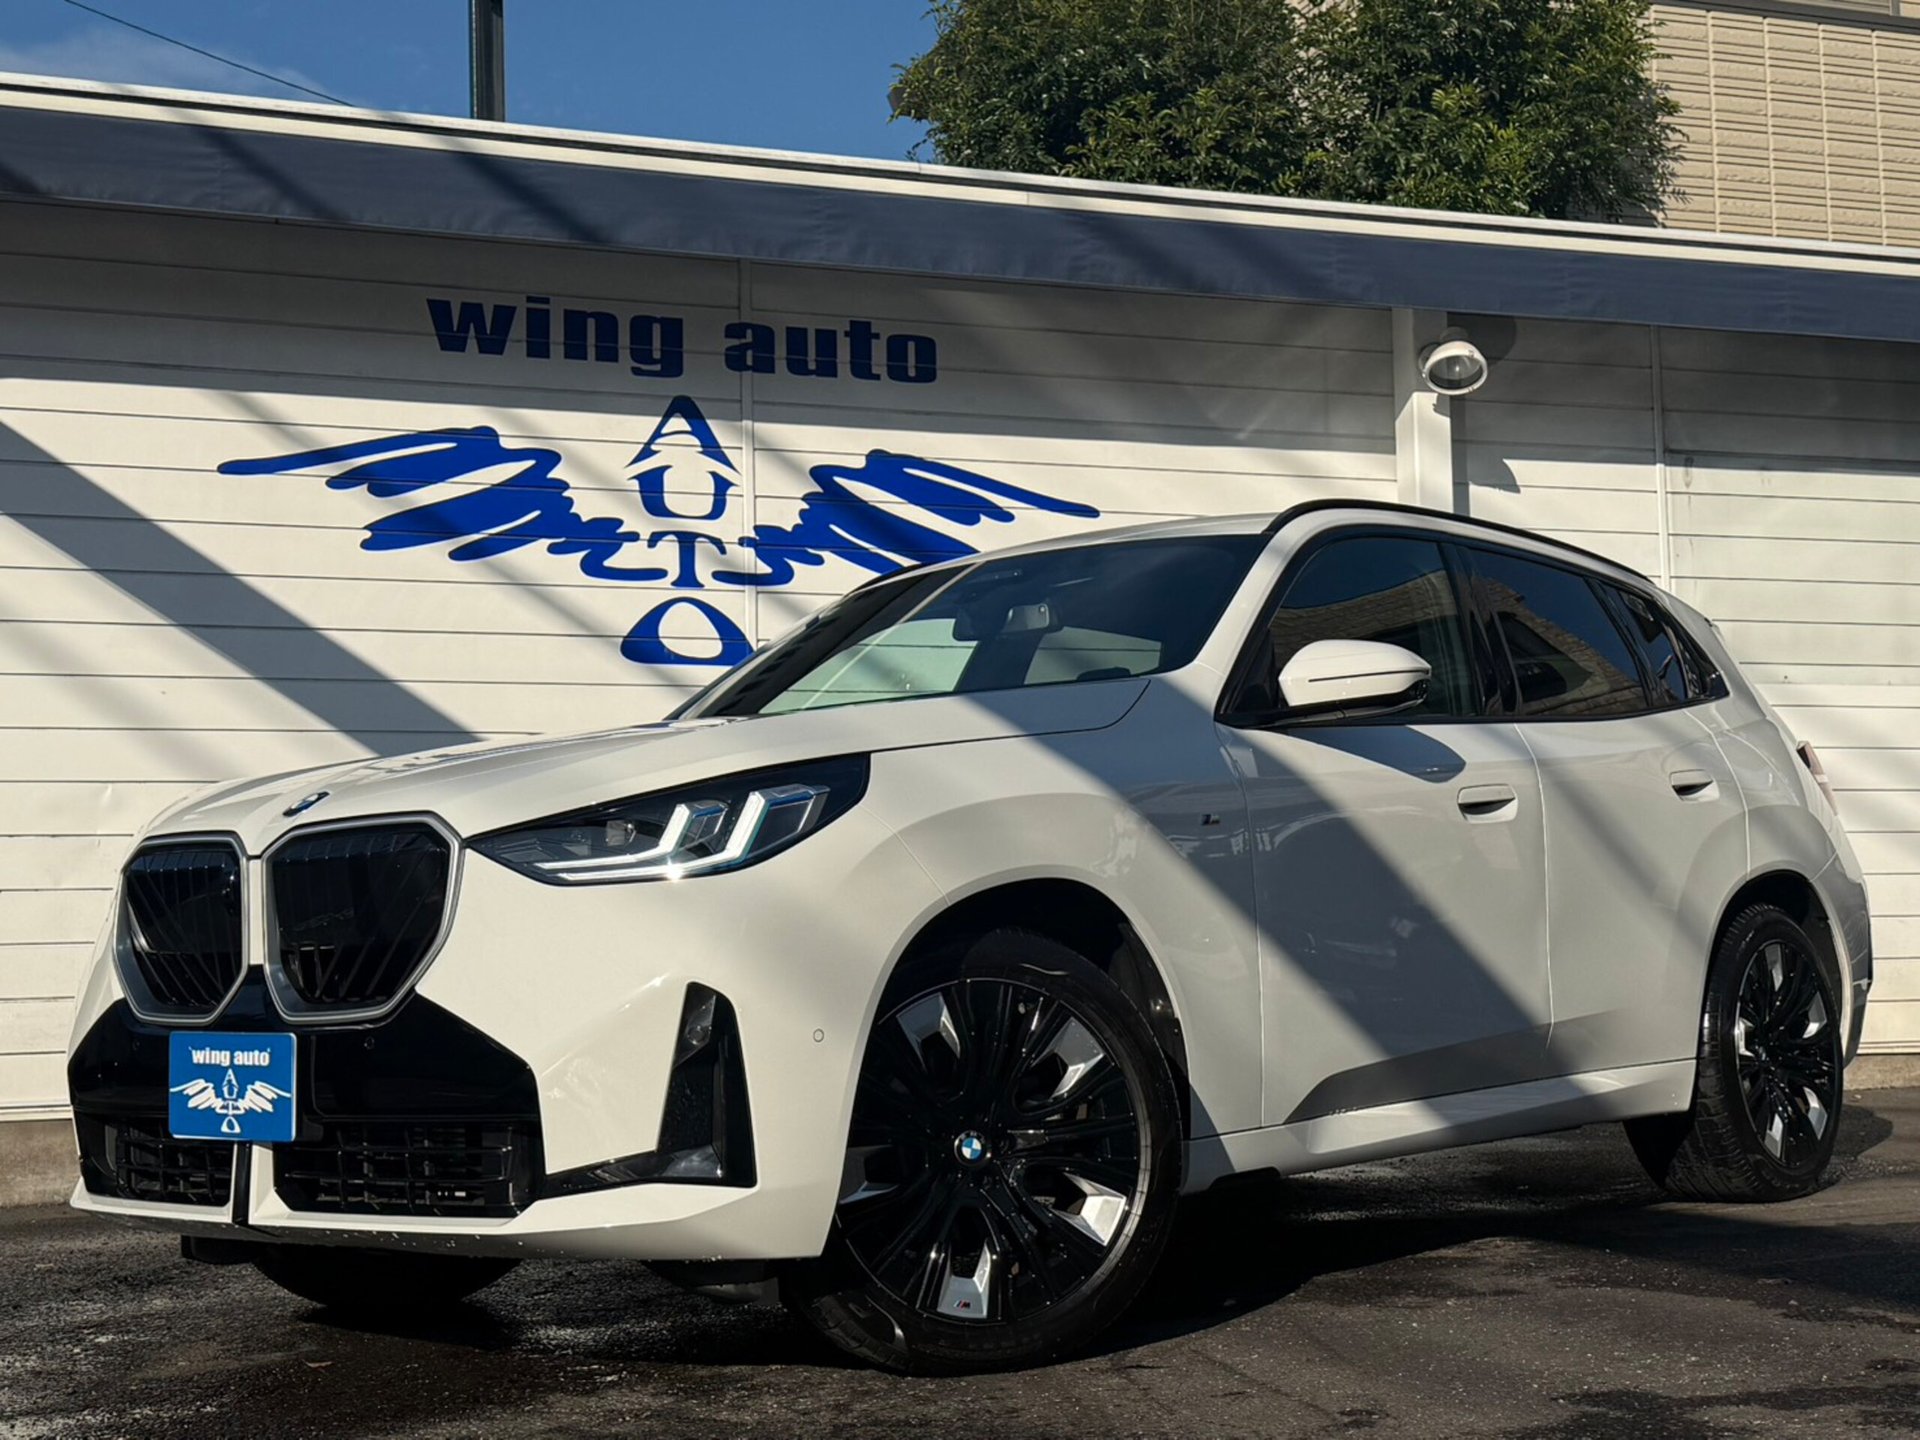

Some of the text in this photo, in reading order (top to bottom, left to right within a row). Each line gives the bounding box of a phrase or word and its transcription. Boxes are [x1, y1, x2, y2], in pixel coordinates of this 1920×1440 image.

[426, 296, 938, 384] wing auto
[619, 394, 755, 666] AUTO
